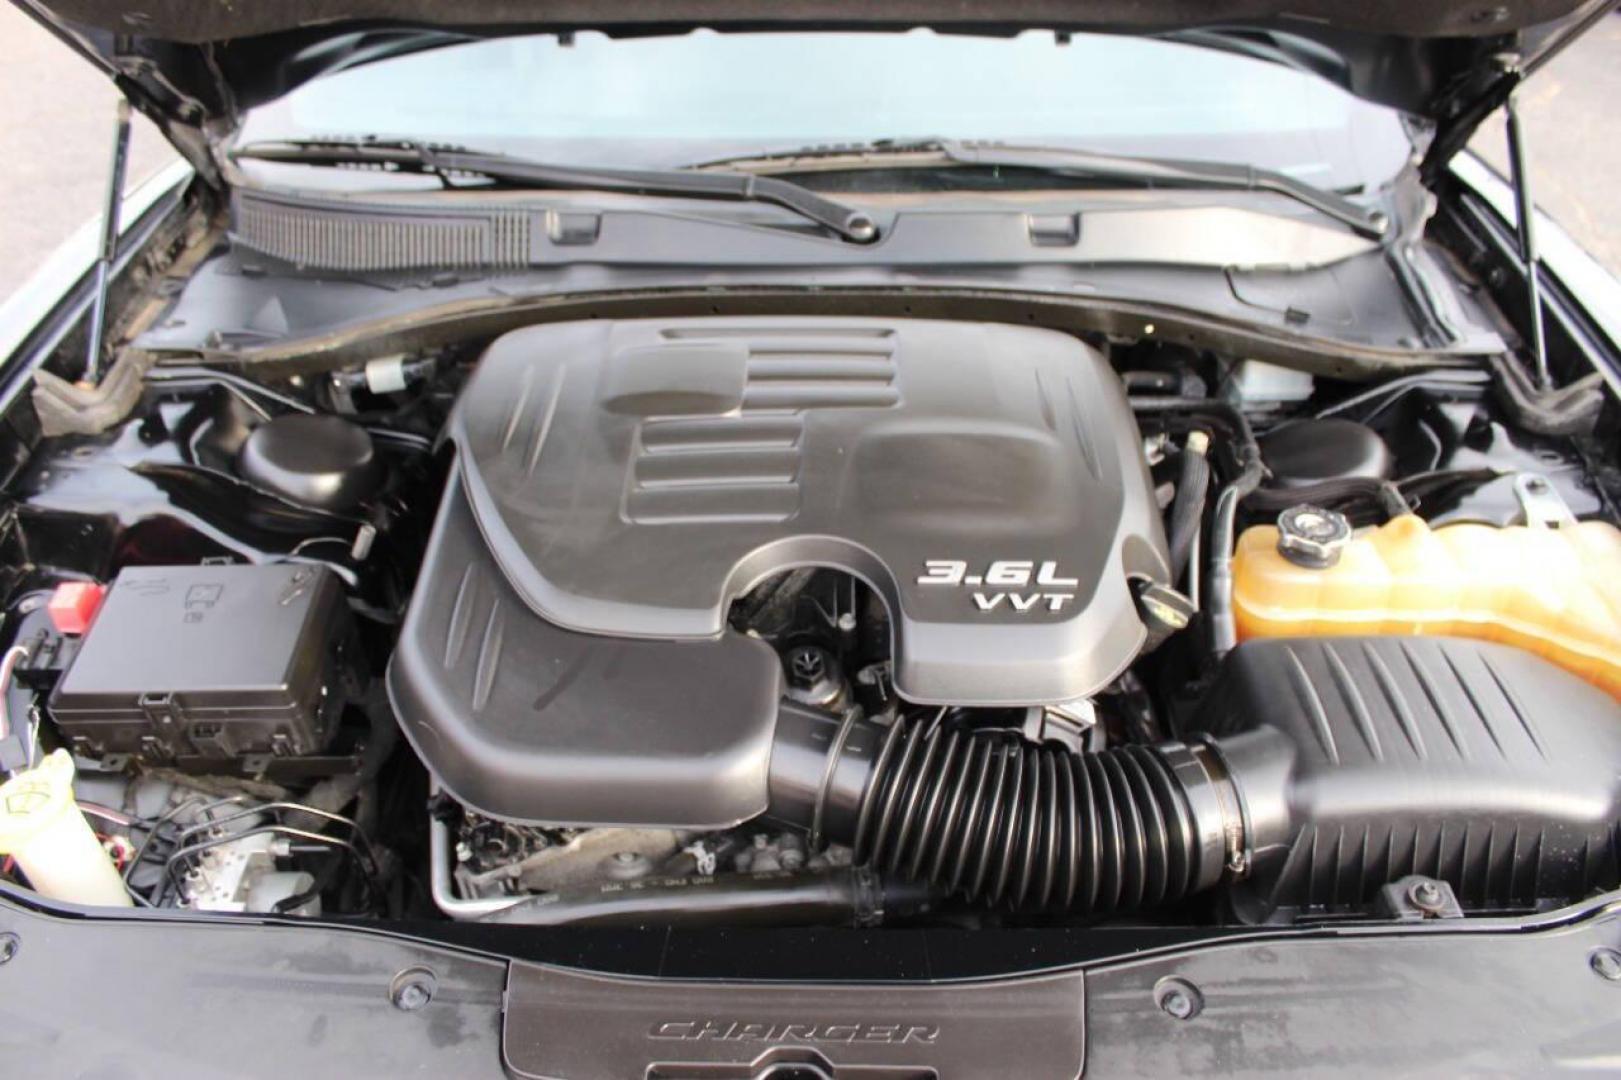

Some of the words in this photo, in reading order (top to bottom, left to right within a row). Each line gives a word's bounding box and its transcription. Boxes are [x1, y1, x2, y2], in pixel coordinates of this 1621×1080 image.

[917, 560, 1079, 587] 3.6L
[973, 593, 1075, 611] VVT
[647, 1020, 941, 1044] CHARGER
